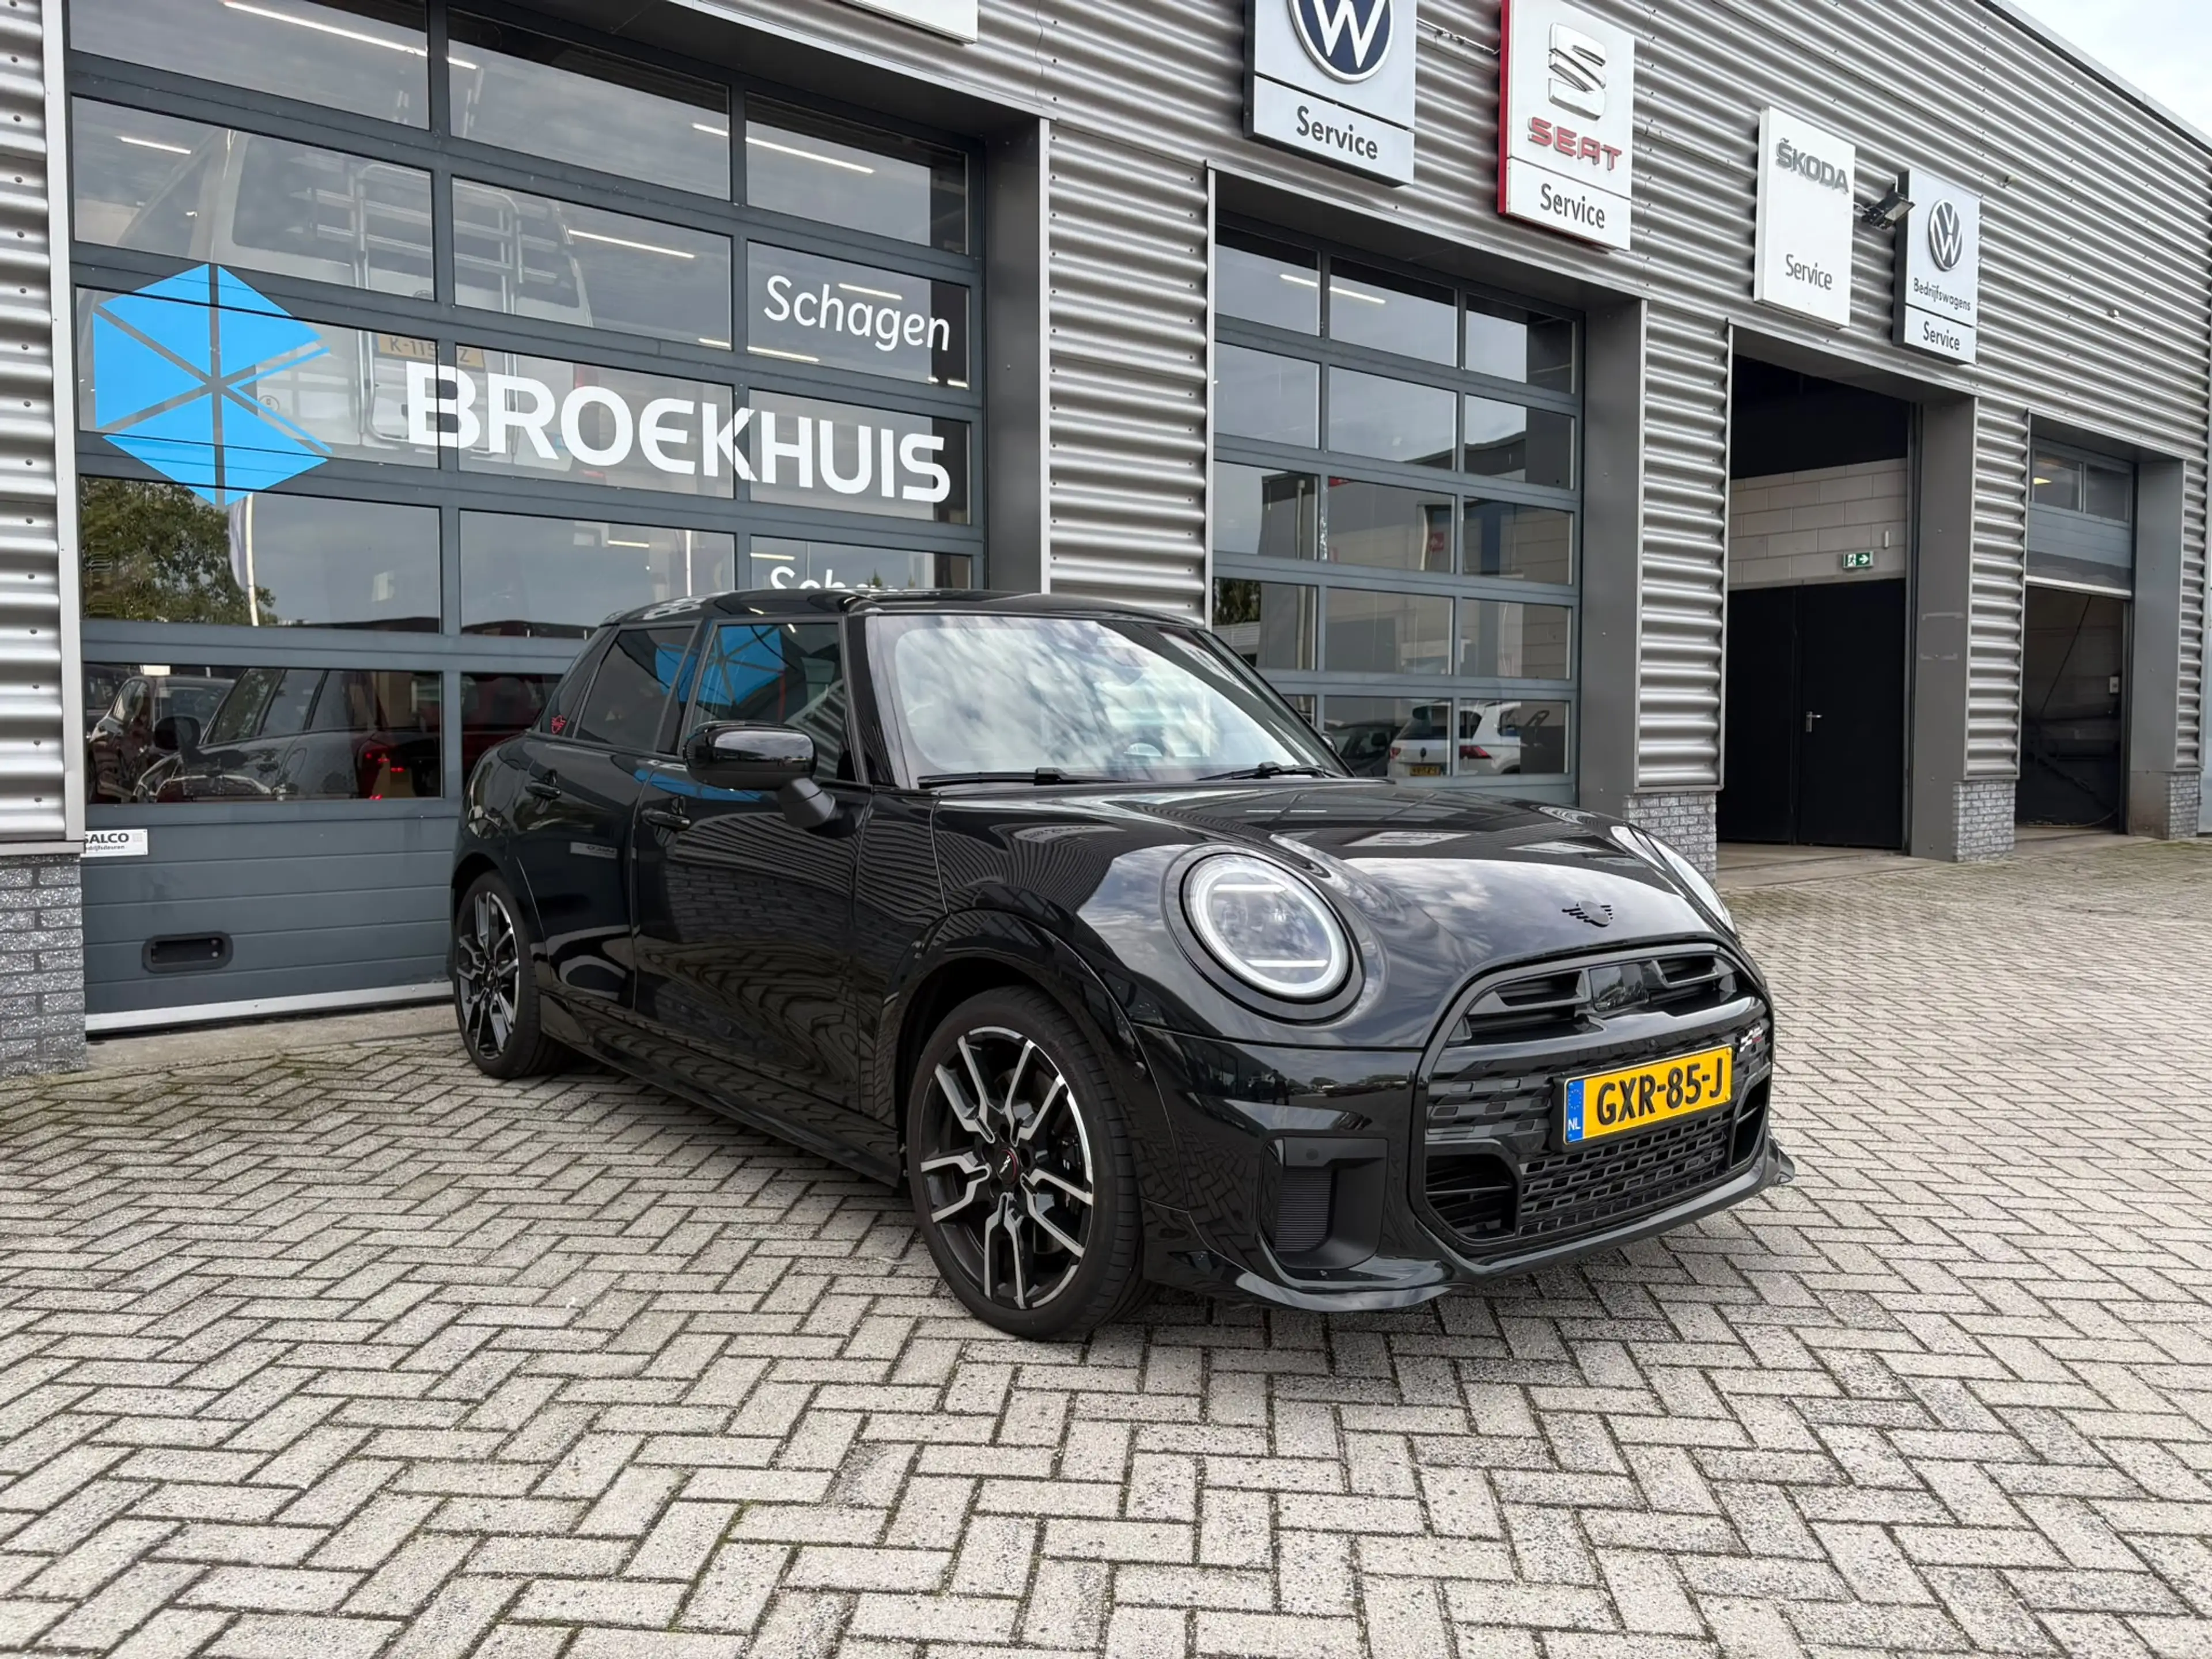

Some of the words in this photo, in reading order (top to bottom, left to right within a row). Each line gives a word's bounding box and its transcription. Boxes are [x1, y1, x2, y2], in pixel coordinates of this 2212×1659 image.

[1296, 105, 1378, 160] Service
[1528, 116, 1622, 171] SEAT
[1776, 138, 1849, 195] ŠKODA
[1540, 183, 1605, 229] Service
[1786, 253, 1832, 290] Service
[1914, 278, 1971, 311] Bedrijfswagens
[763, 275, 950, 351] Schagen
[1923, 320, 1960, 351] Service
[405, 360, 951, 503] BROEKHUIS
[1597, 1058, 1724, 1125] GXR-85-J
[1567, 1118, 1581, 1131] NL
